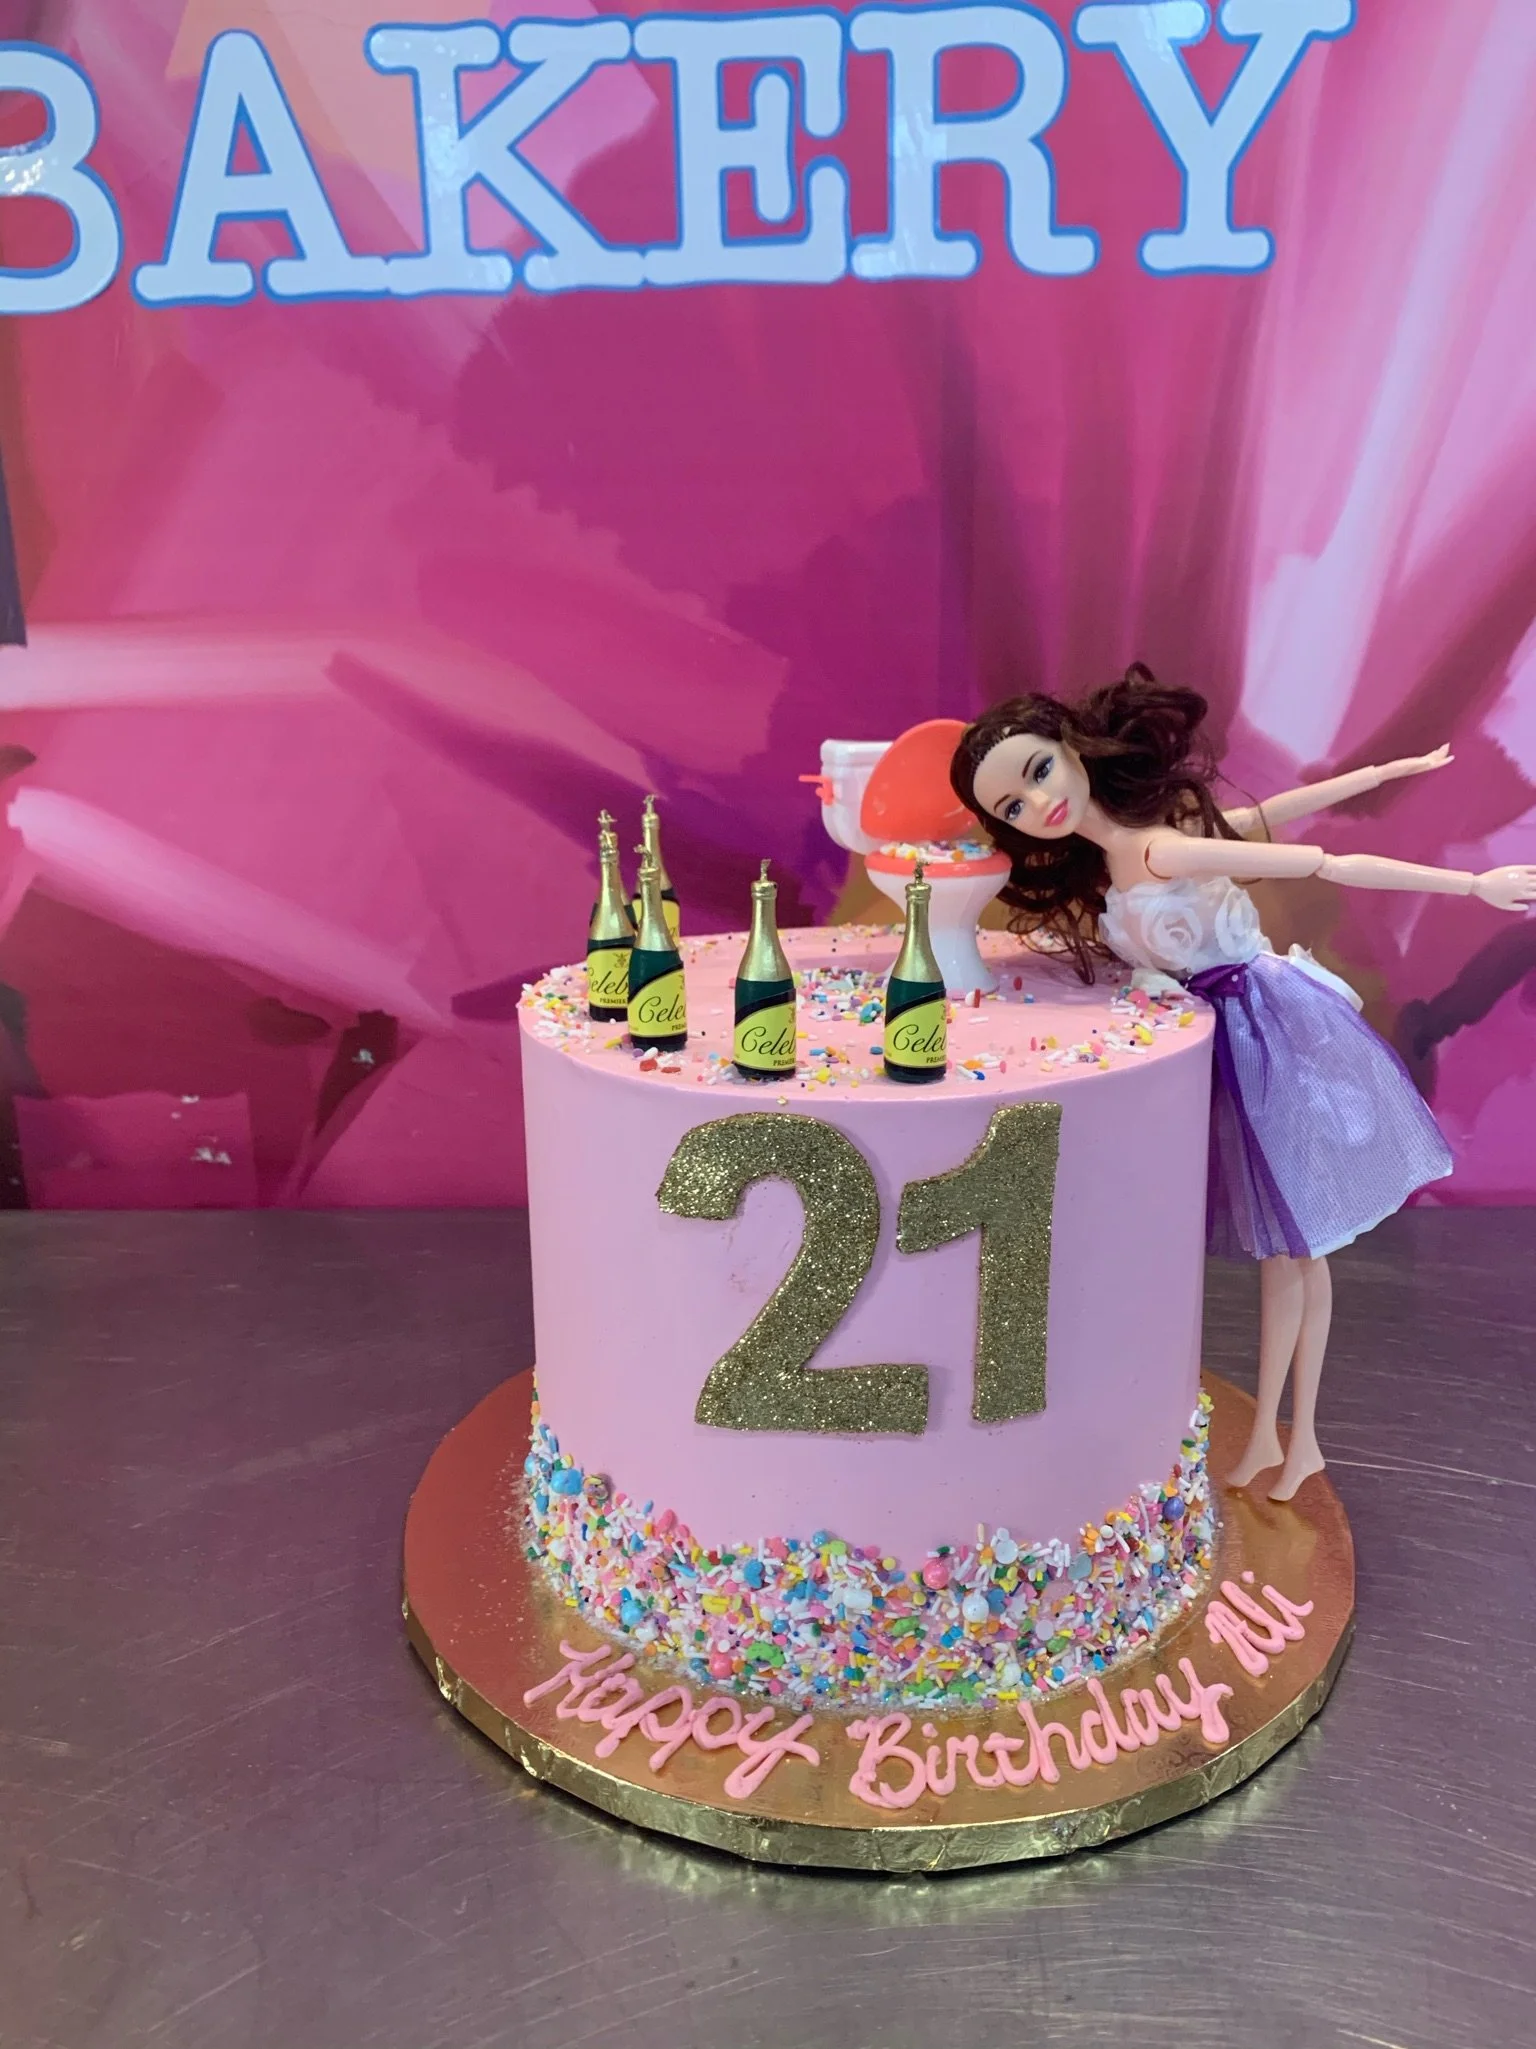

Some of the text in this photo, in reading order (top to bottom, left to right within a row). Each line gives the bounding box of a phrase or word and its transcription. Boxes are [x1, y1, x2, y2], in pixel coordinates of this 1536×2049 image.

[0, 0, 1356, 315] BAKERY
[655, 1101, 1062, 1437] 21
[523, 1639, 821, 1799] Happy
[845, 1657, 1234, 1809] Birthday
